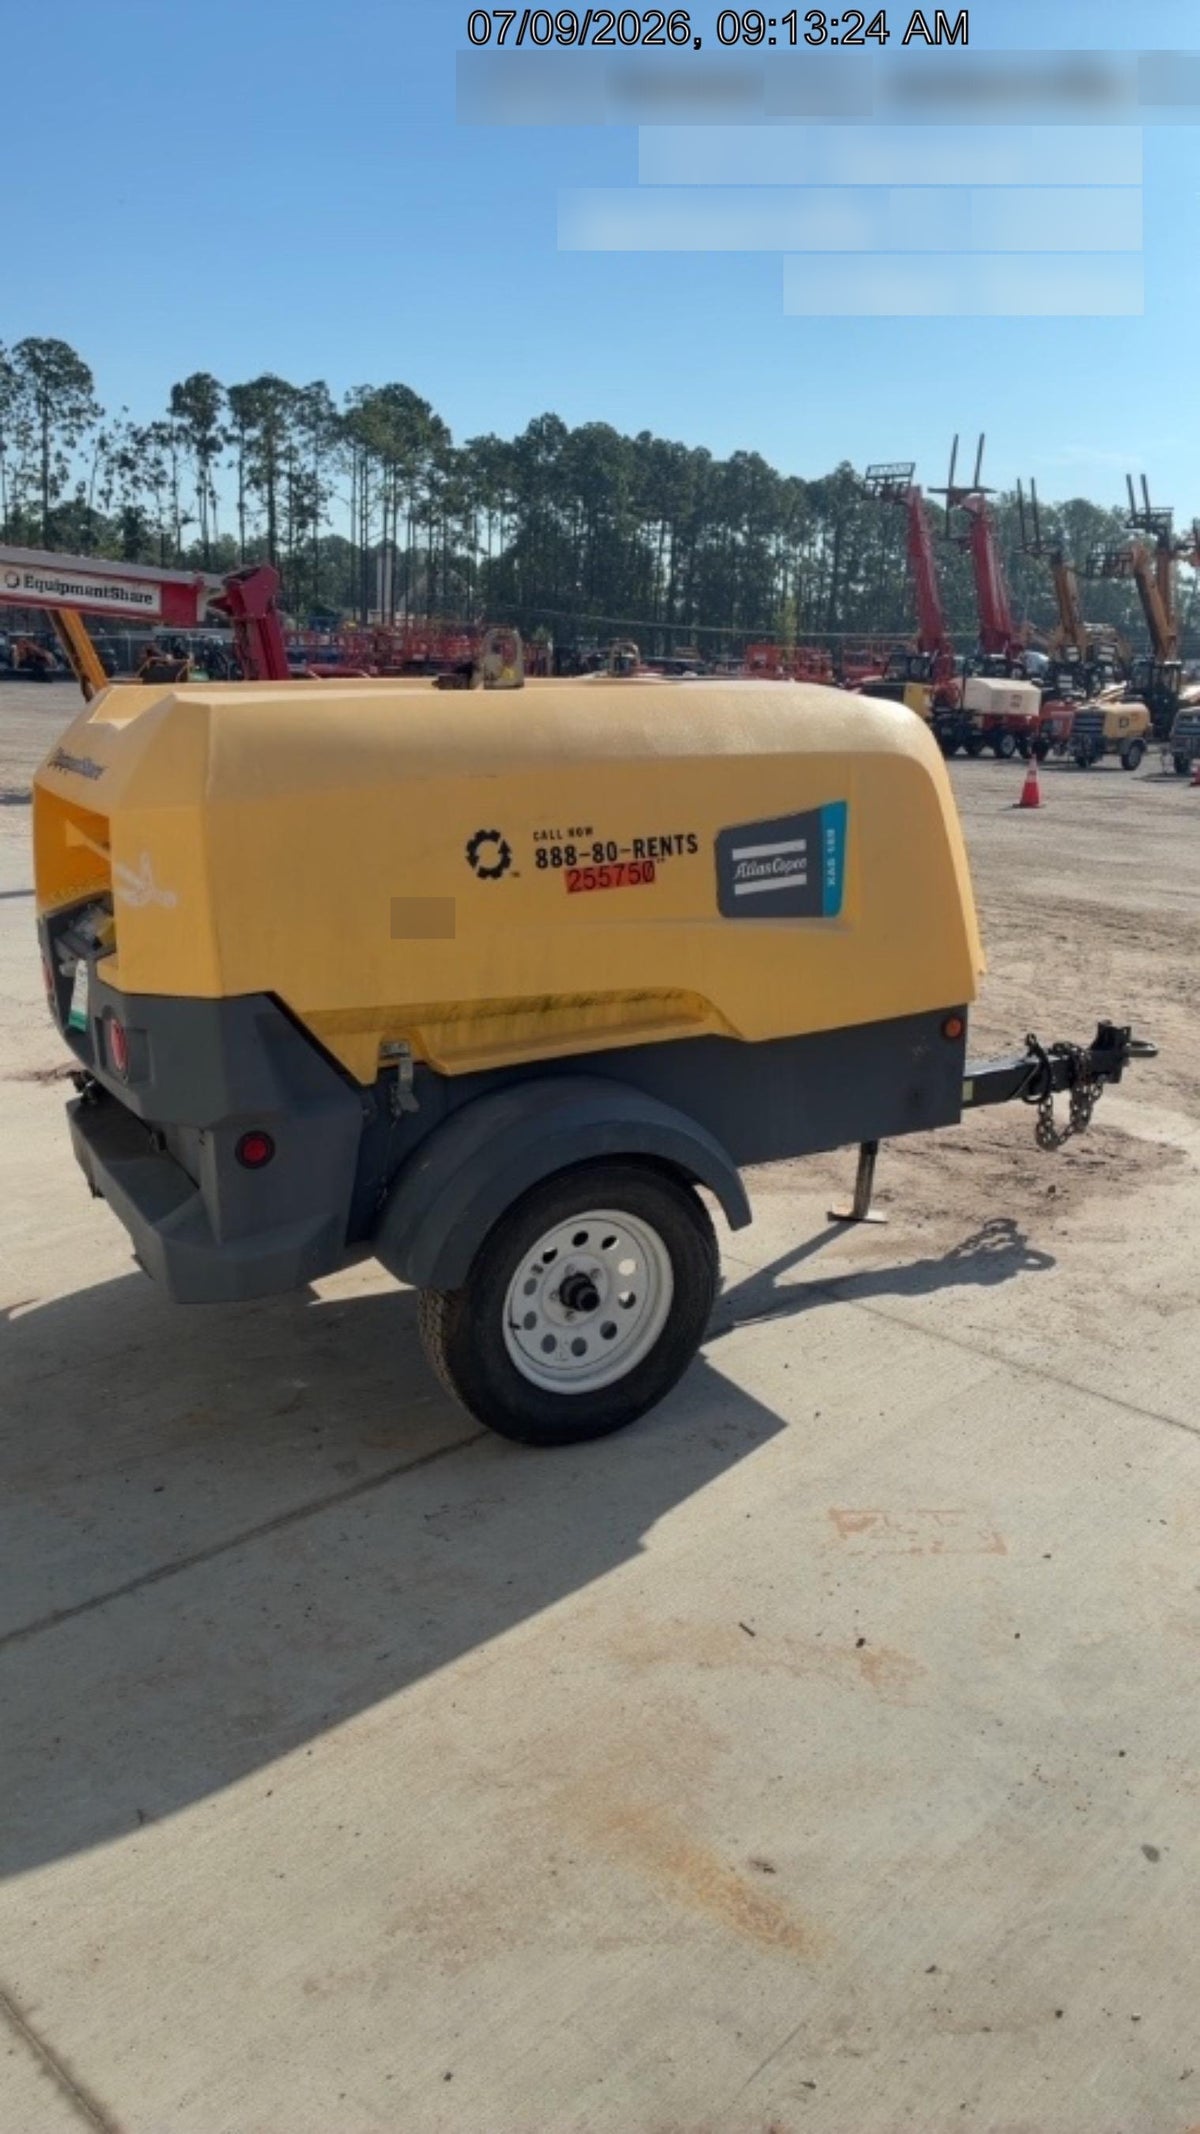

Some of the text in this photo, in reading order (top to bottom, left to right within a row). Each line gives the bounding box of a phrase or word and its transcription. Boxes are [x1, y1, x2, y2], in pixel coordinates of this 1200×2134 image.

[23, 574, 153, 605] EquipmentShare
[533, 827, 594, 841] CALL NOW
[535, 834, 699, 869] 888-80-RENTS
[567, 861, 656, 893] 255750
